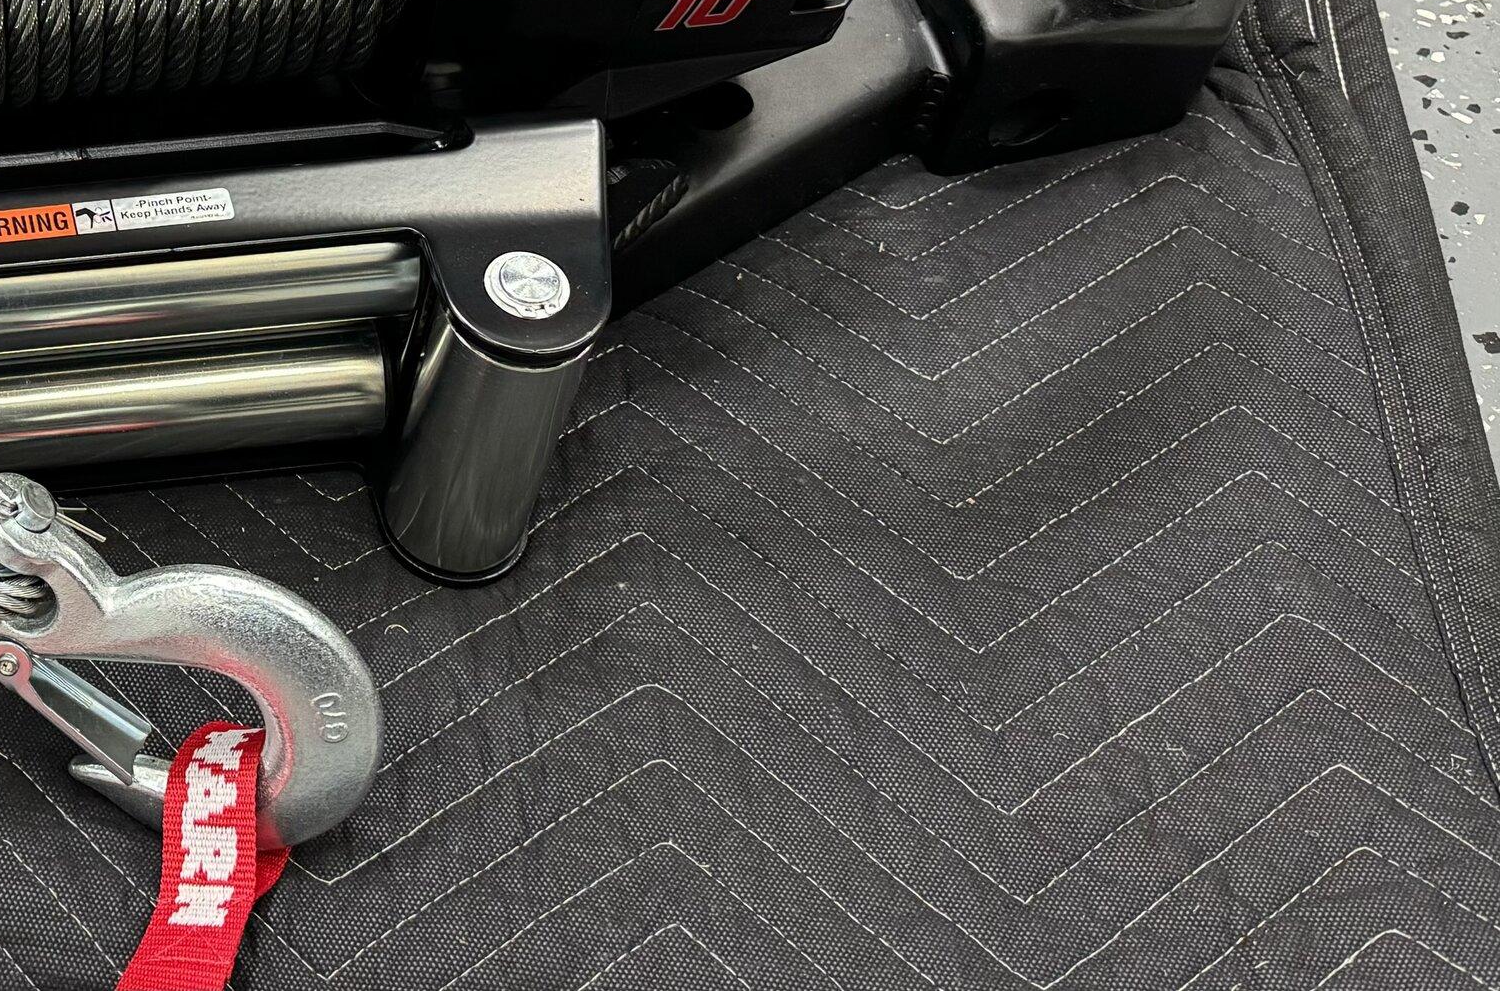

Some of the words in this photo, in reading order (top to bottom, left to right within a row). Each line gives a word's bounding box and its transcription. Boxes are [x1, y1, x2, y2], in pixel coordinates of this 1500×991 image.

[121, 211, 151, 220] Keep
[155, 206, 192, 216] Hands
[196, 203, 226, 211] Away
[167, 728, 263, 927] WARN
